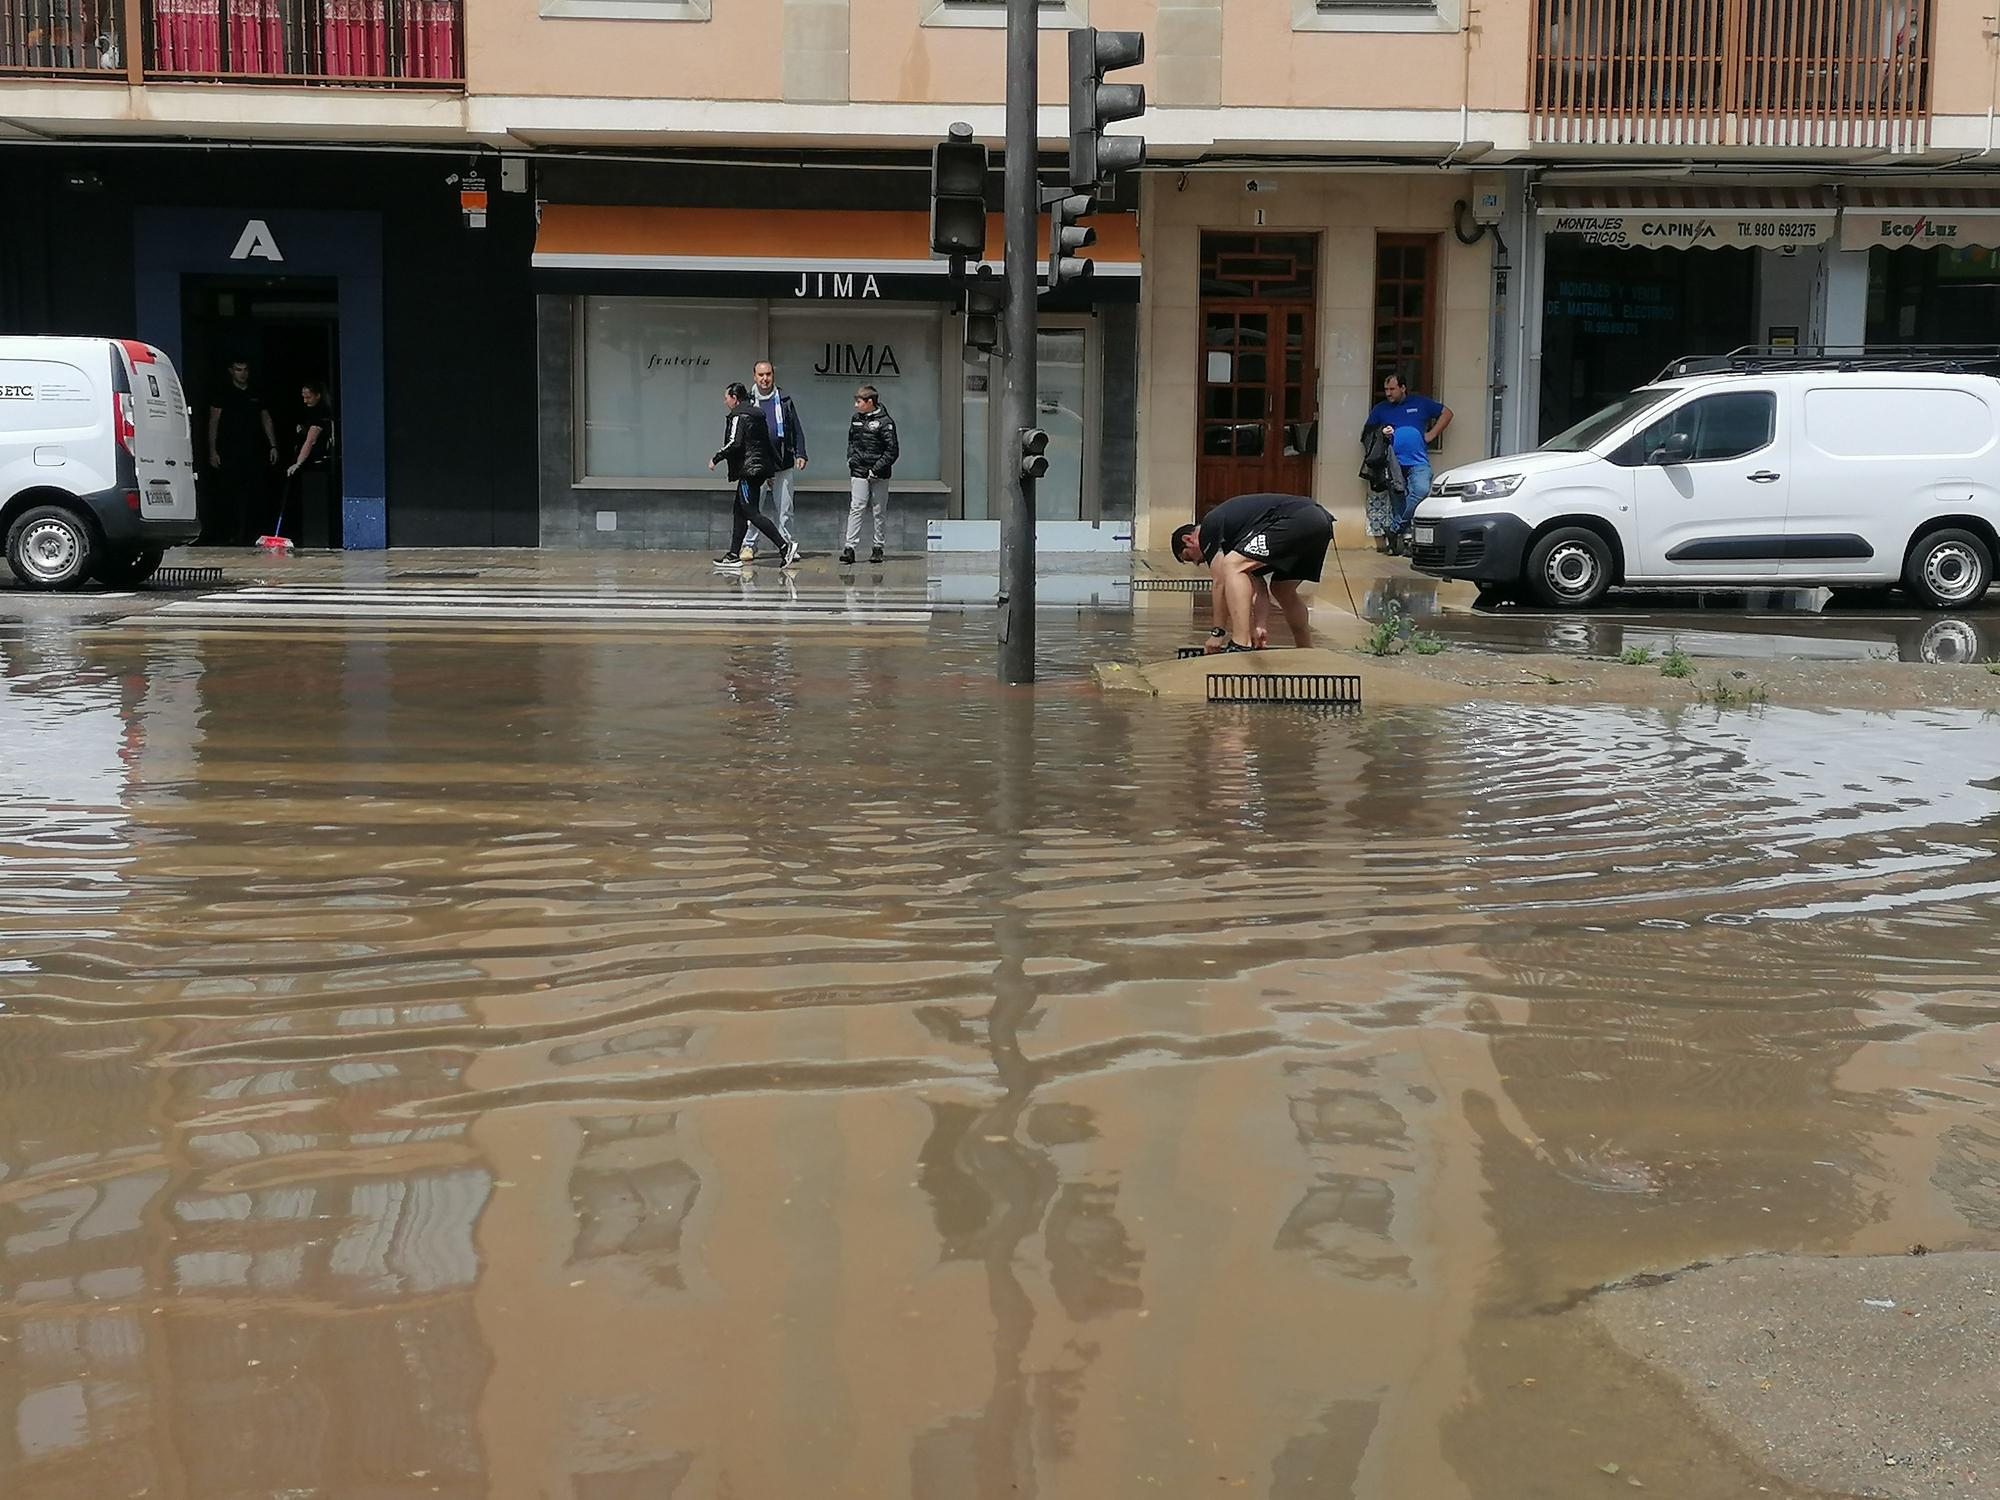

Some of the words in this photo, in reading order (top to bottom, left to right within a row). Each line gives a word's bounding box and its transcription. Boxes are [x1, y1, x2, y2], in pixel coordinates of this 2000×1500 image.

[1556, 217, 1624, 230] MONTAJES
[1755, 223, 1775, 236] 980
[1779, 223, 1817, 237] 692375
[229, 219, 285, 262] A
[794, 272, 881, 299] JIMA
[1546, 301, 1561, 315] DE
[1567, 302, 1615, 317] MATERIAL
[814, 343, 901, 375] JIMA
